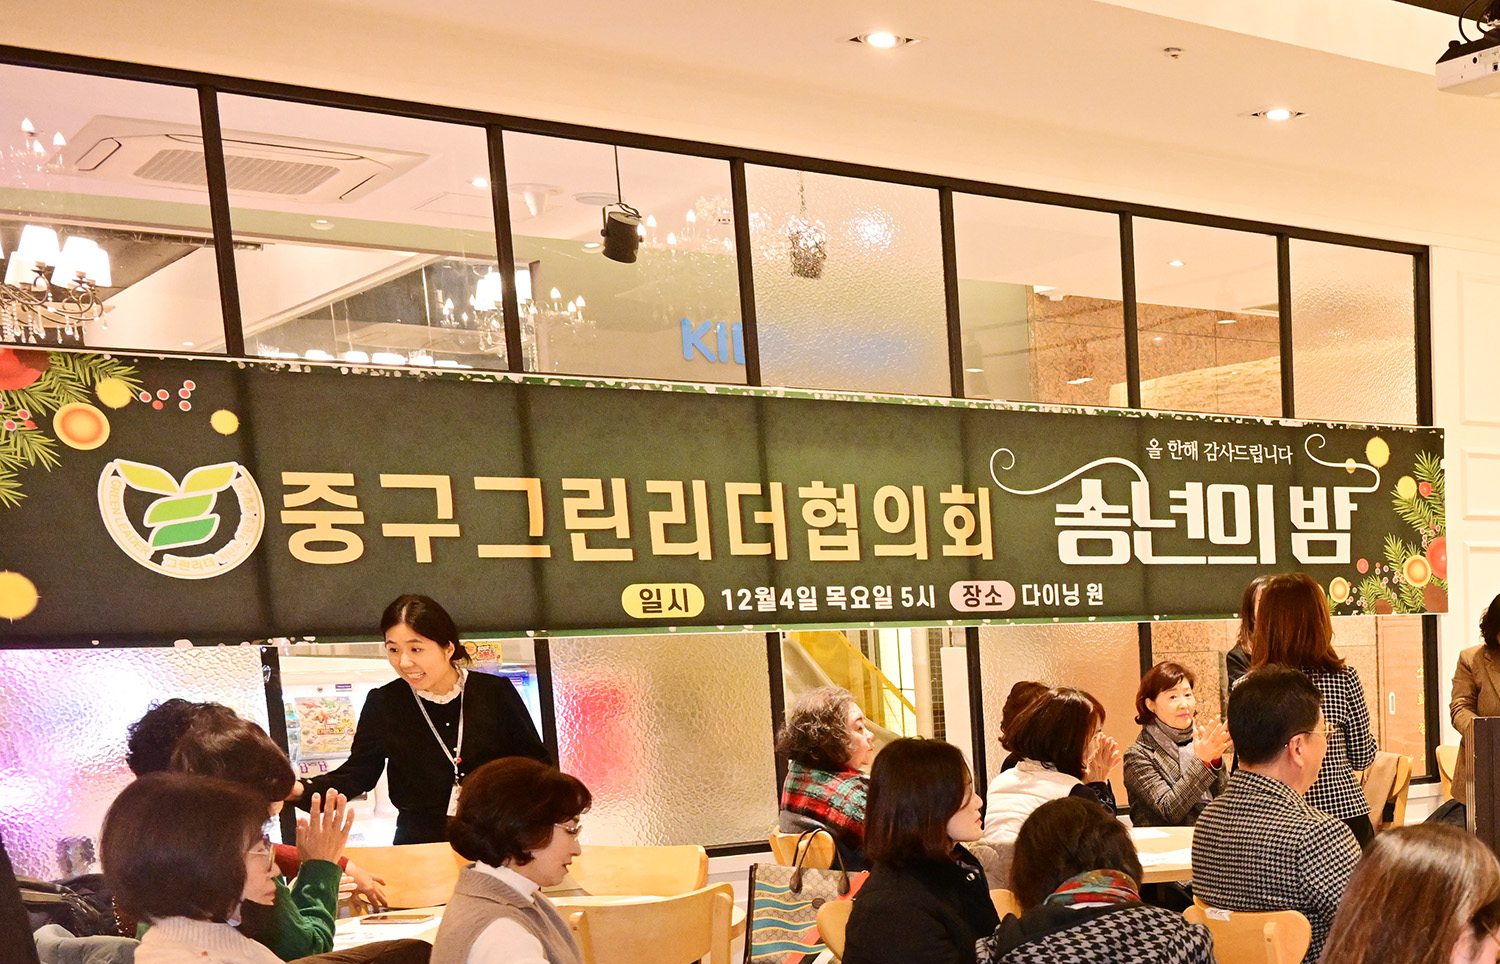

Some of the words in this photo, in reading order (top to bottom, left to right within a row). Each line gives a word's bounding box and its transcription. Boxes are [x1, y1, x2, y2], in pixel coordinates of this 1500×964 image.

[1145, 437, 1164, 460] 올
[1167, 439, 1199, 462] 한해
[1203, 441, 1294, 465] 감사드립니다
[110, 480, 122, 515] GREEN
[280, 470, 994, 565] 중구그린리더협의회
[115, 514, 153, 556] LEADER
[167, 557, 216, 571] 그린리더
[639, 588, 689, 614] 일시
[825, 585, 893, 611] 목요일
[900, 584, 936, 609] 5시
[962, 584, 1003, 608] 장소
